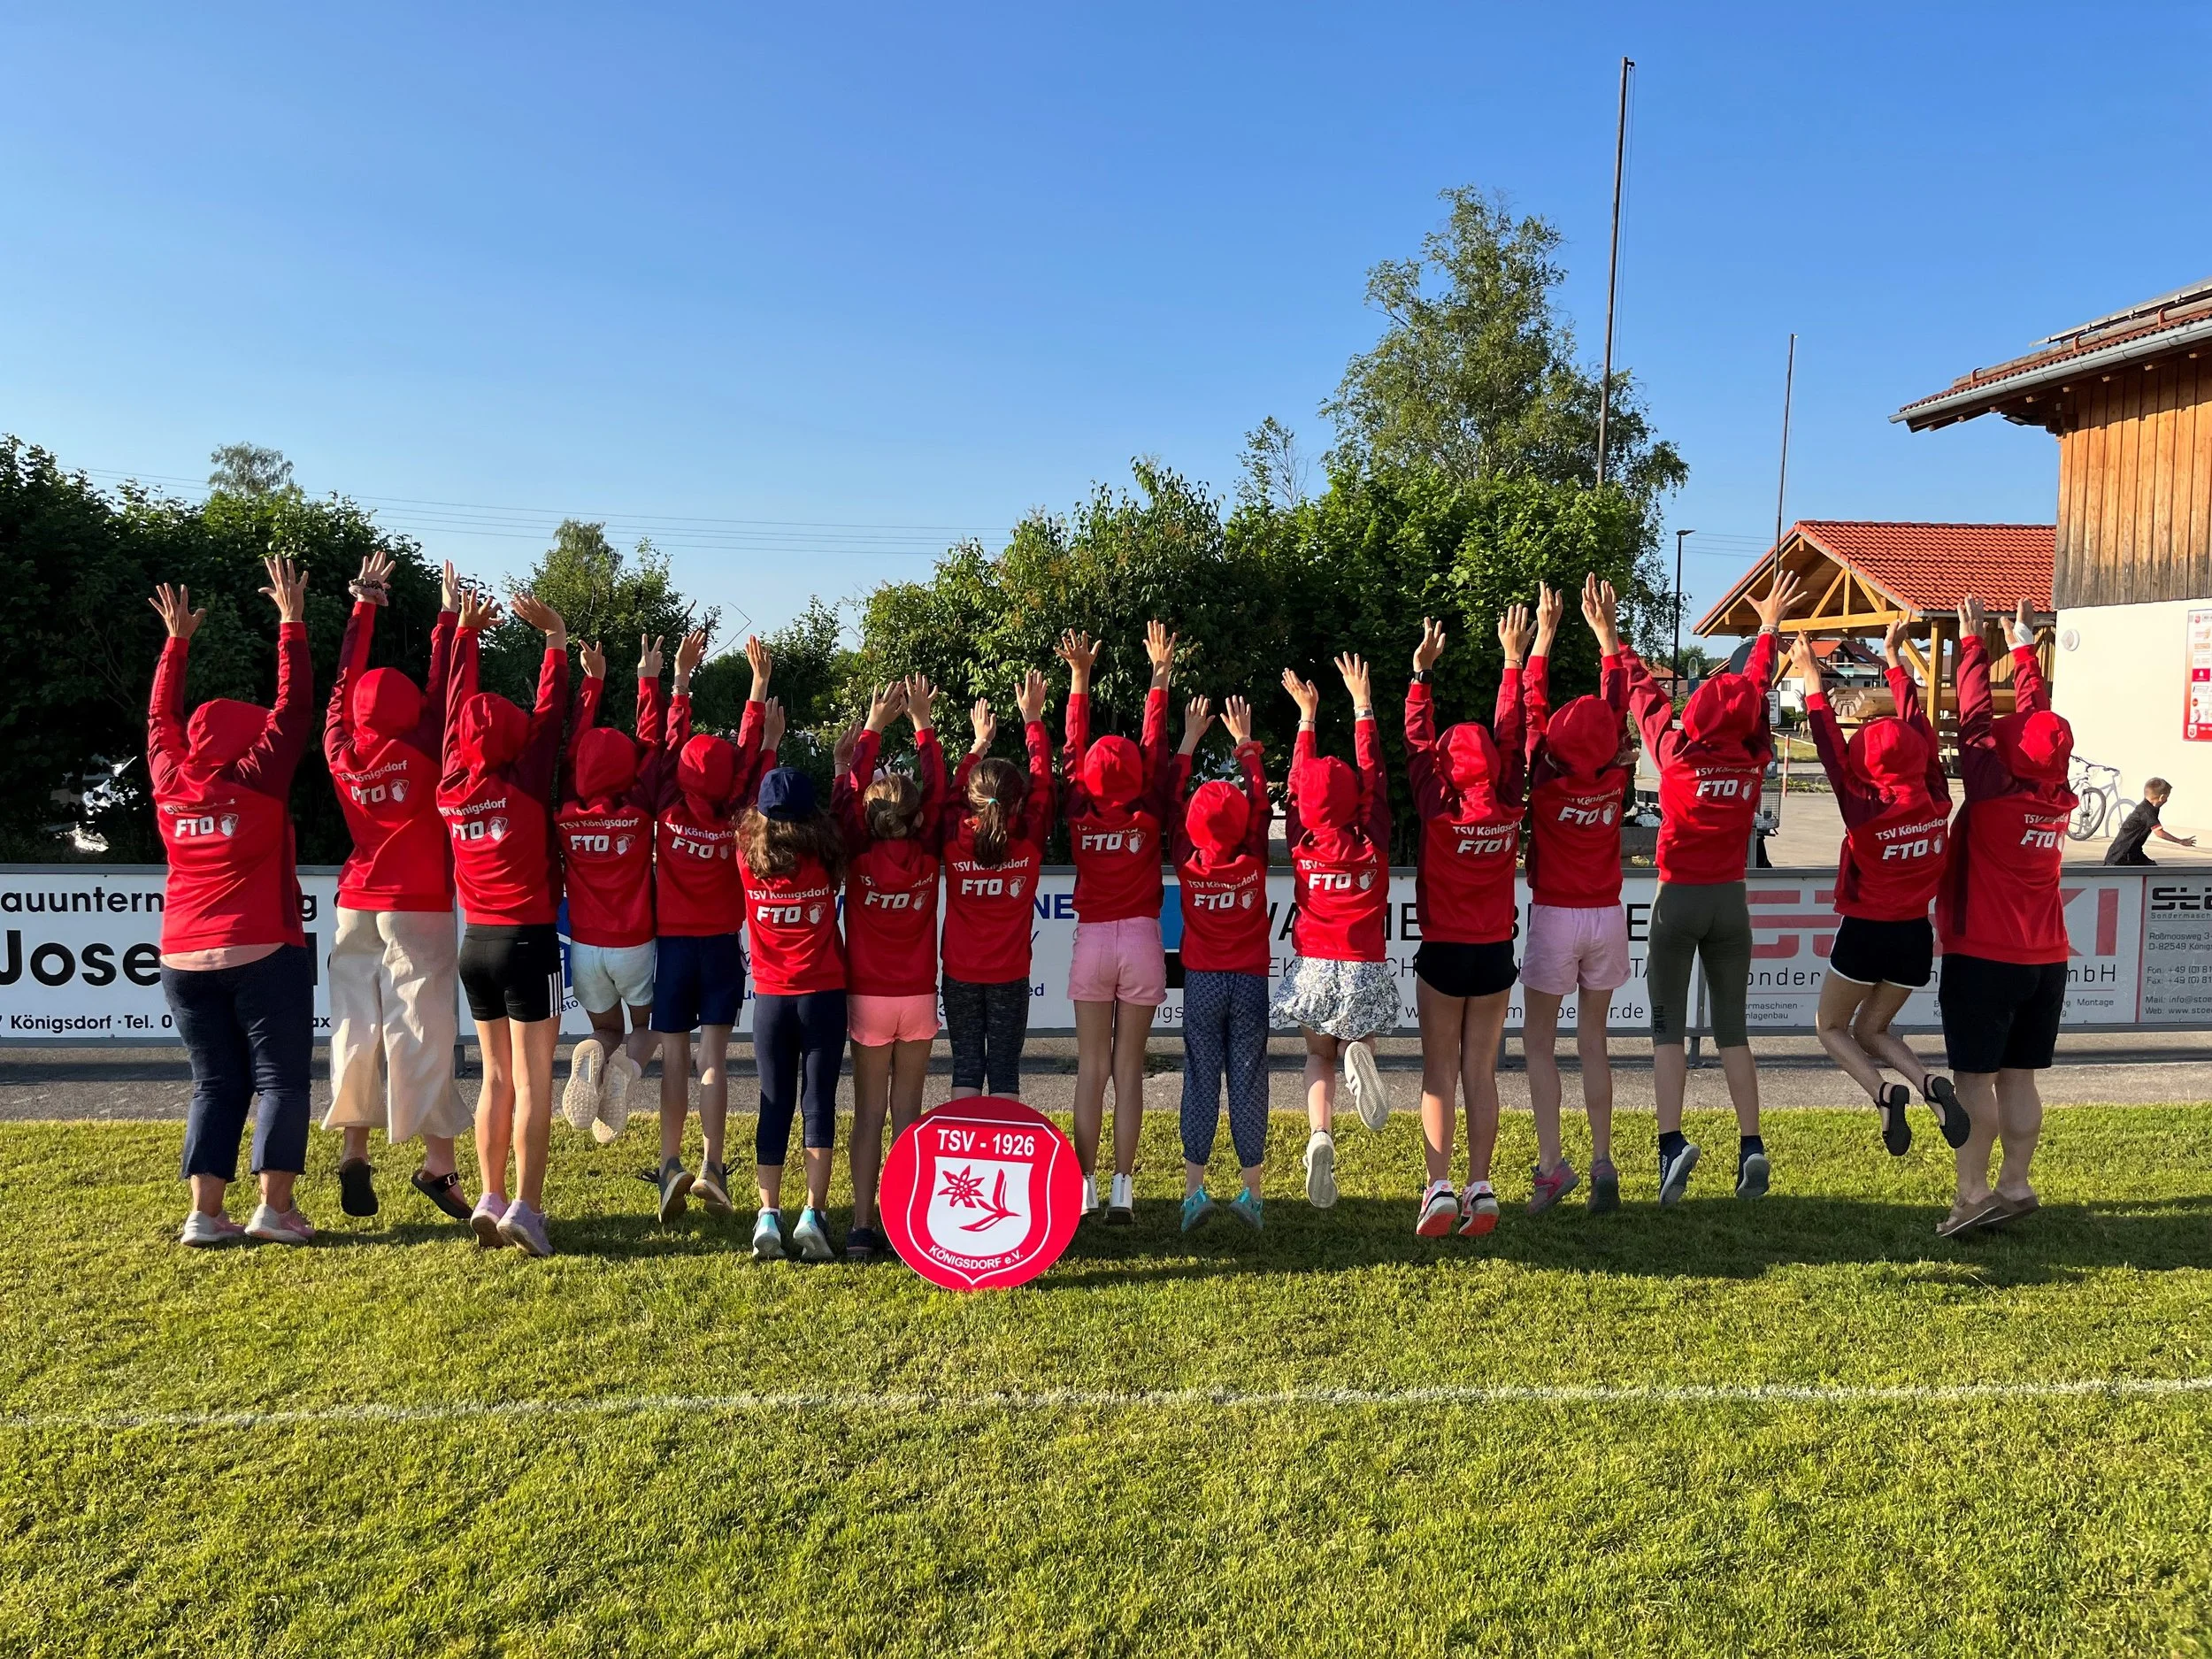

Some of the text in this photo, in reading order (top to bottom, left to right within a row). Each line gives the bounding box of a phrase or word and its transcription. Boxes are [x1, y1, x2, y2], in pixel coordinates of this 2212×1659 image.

[1695, 780, 1739, 797] FTO
[449, 797, 507, 816] Königsdorf
[559, 818, 640, 830] TSV Königsdorf
[1557, 806, 1601, 826] FTO
[2024, 813, 2045, 824] TSV
[174, 816, 214, 838] FTO
[451, 820, 485, 841] FTO
[684, 826, 738, 841] Königsdo
[1452, 826, 1475, 835] TSV
[1875, 818, 1947, 841] TSV Königsdor
[570, 834, 610, 851] FTO
[672, 836, 715, 859] FTO
[1081, 833, 1123, 851] FTO
[1456, 838, 1503, 855] FTO
[2020, 829, 2057, 849] FTO
[1882, 839, 1929, 860] FTO
[952, 861, 971, 872] TSV
[859, 874, 876, 887] TS
[961, 879, 1003, 896] FTO
[1187, 879, 1204, 888] TSV
[1309, 872, 1352, 891] FTO
[747, 889, 767, 900] TSV
[864, 890, 910, 909] FTO
[1194, 891, 1235, 910] FTO
[757, 905, 802, 923] FTO
[2068, 964, 2116, 983] mbH
[11, 1014, 111, 1033] Königsdorf
[1745, 1012, 1789, 1021] nlagenbau
[936, 1129, 976, 1152] TSV
[992, 1133, 1035, 1156] 1926
[928, 1245, 1024, 1270] KÖNIGSDORF e.V.
